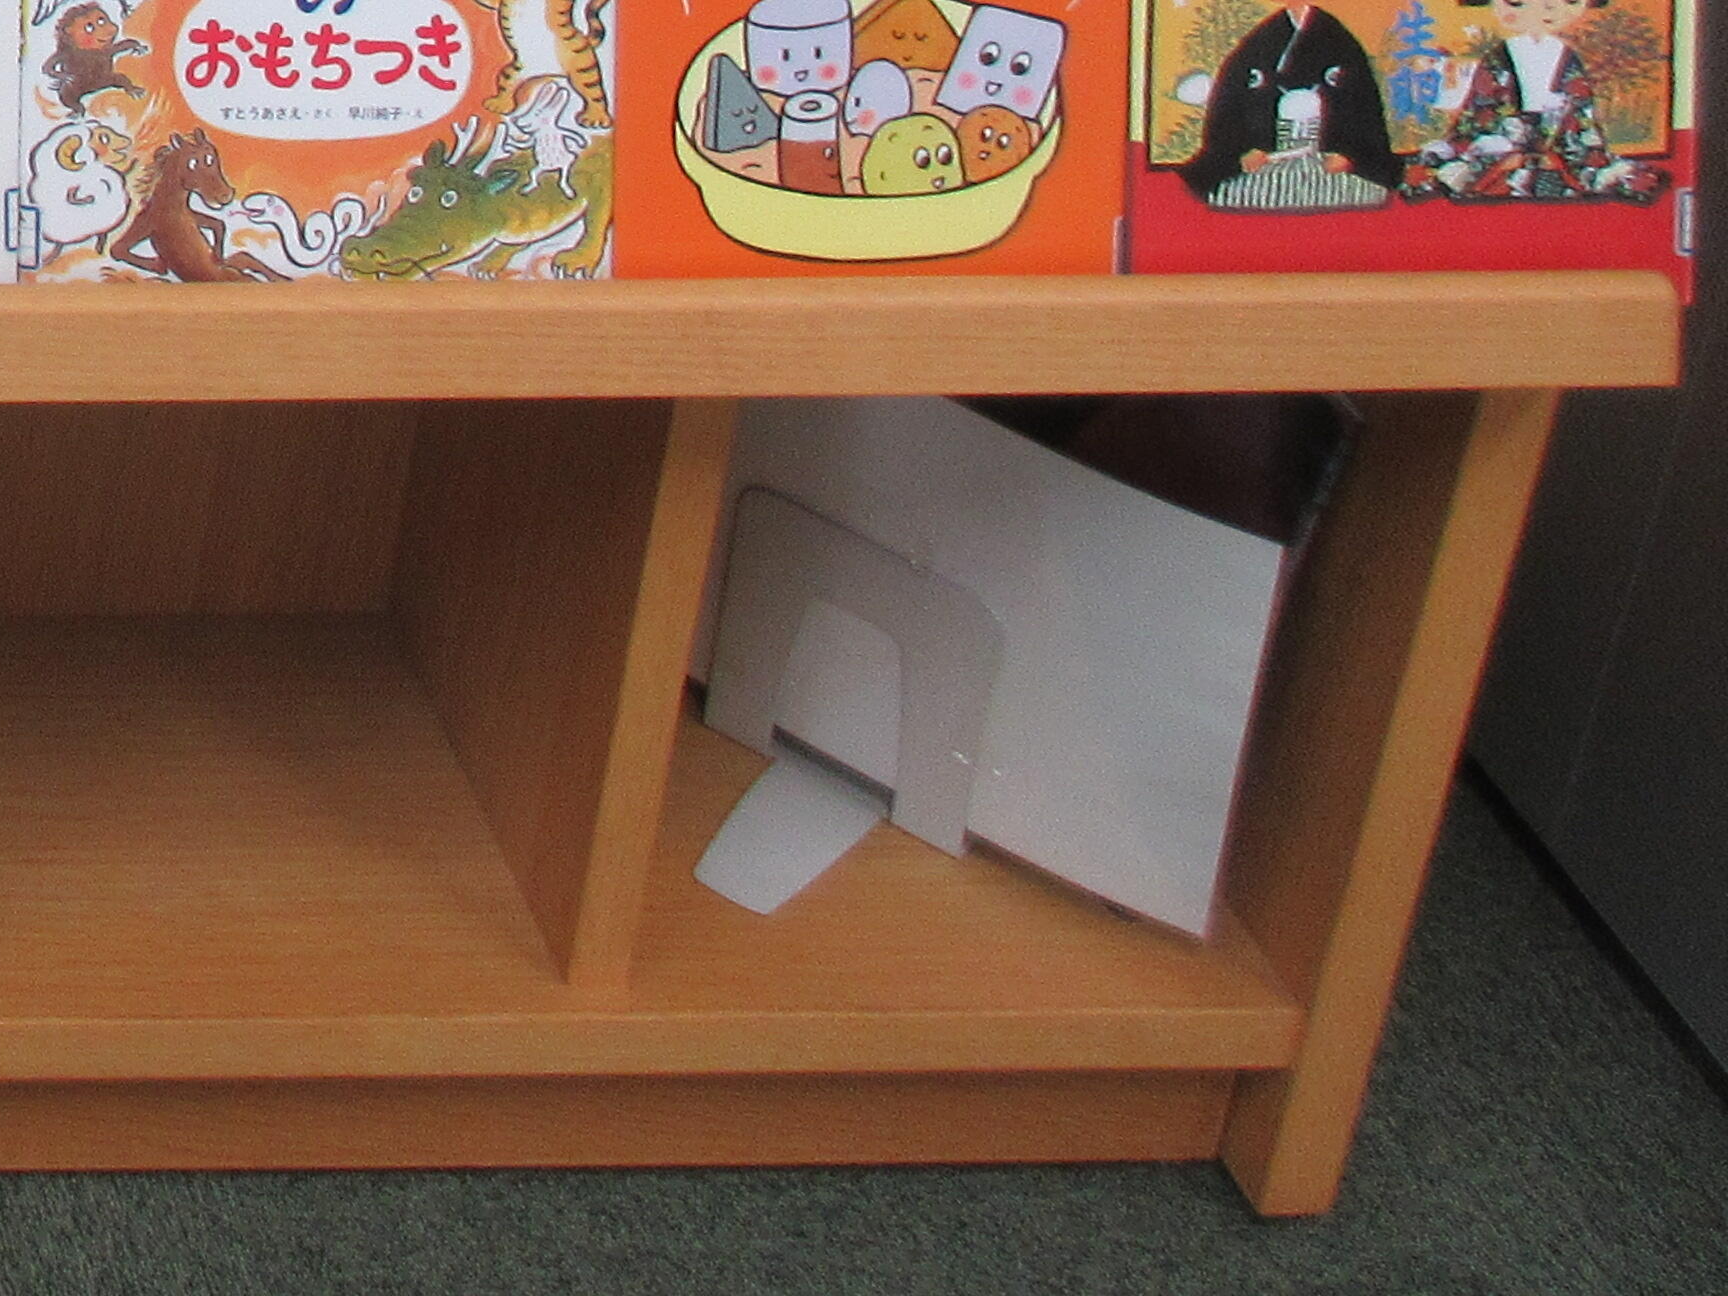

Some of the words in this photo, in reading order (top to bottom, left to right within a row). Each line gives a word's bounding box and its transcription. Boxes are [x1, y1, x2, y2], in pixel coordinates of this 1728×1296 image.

[184, 14, 463, 92] おもちつき
